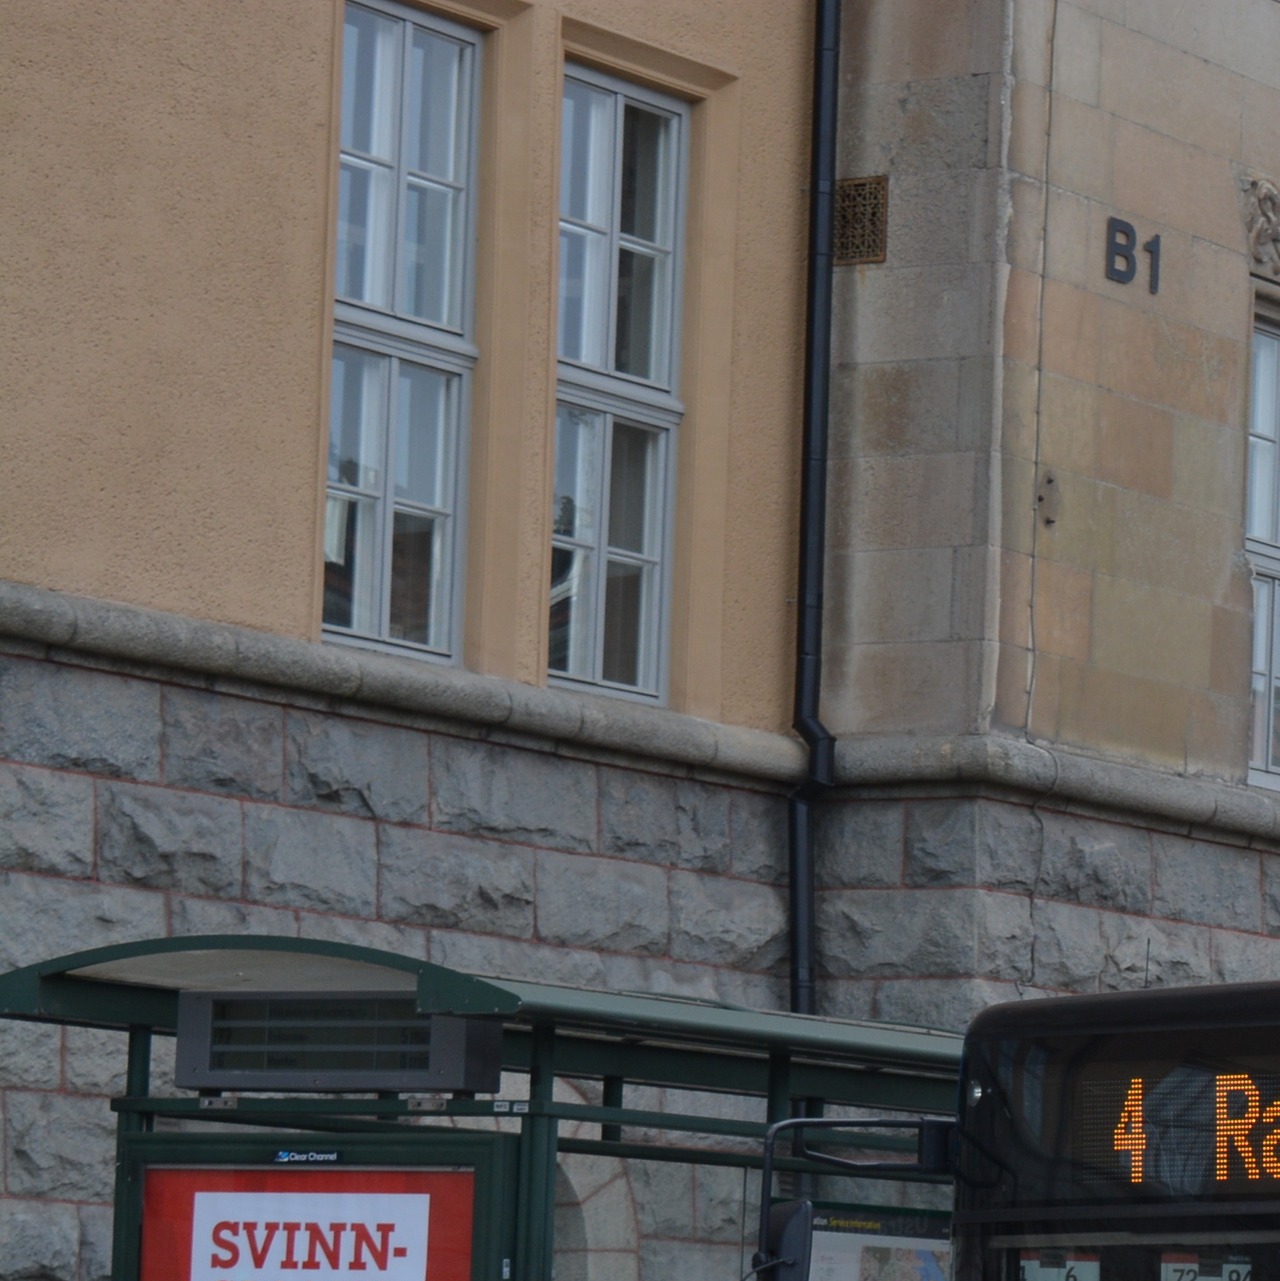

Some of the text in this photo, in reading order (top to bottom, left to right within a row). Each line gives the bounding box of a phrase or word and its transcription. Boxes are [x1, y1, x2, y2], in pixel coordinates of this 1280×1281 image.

[1105, 216, 1161, 295] B1
[289, 1152, 337, 1161] Clear Channel
[1114, 1078, 1147, 1183] 4
[211, 1221, 408, 1271] SVINN-
